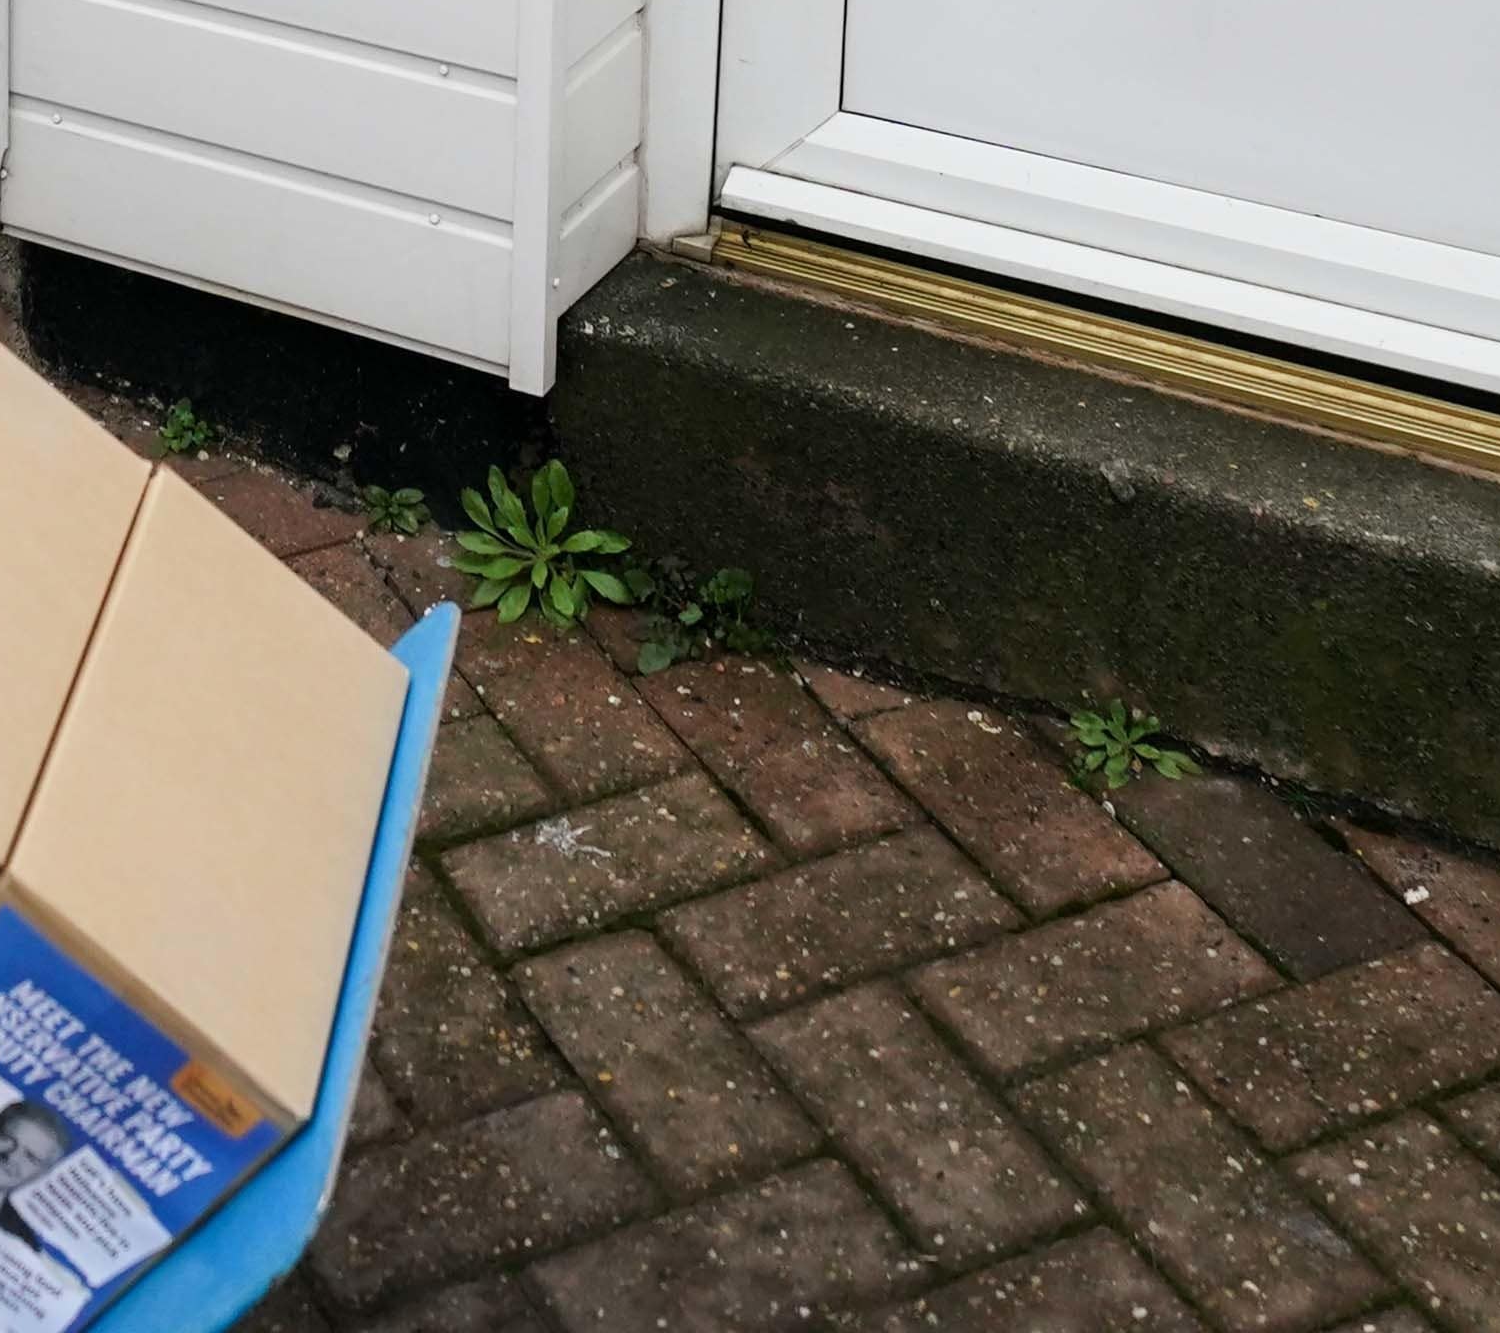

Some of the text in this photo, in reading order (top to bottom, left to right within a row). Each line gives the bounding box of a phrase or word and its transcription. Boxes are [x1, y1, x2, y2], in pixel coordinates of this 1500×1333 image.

[8, 978, 88, 1042] MEET
[76, 1033, 135, 1083] THE
[123, 1073, 195, 1130] NEW
[41, 1079, 183, 1196] CHAIRMAN
[121, 1108, 216, 1182] PARTY
